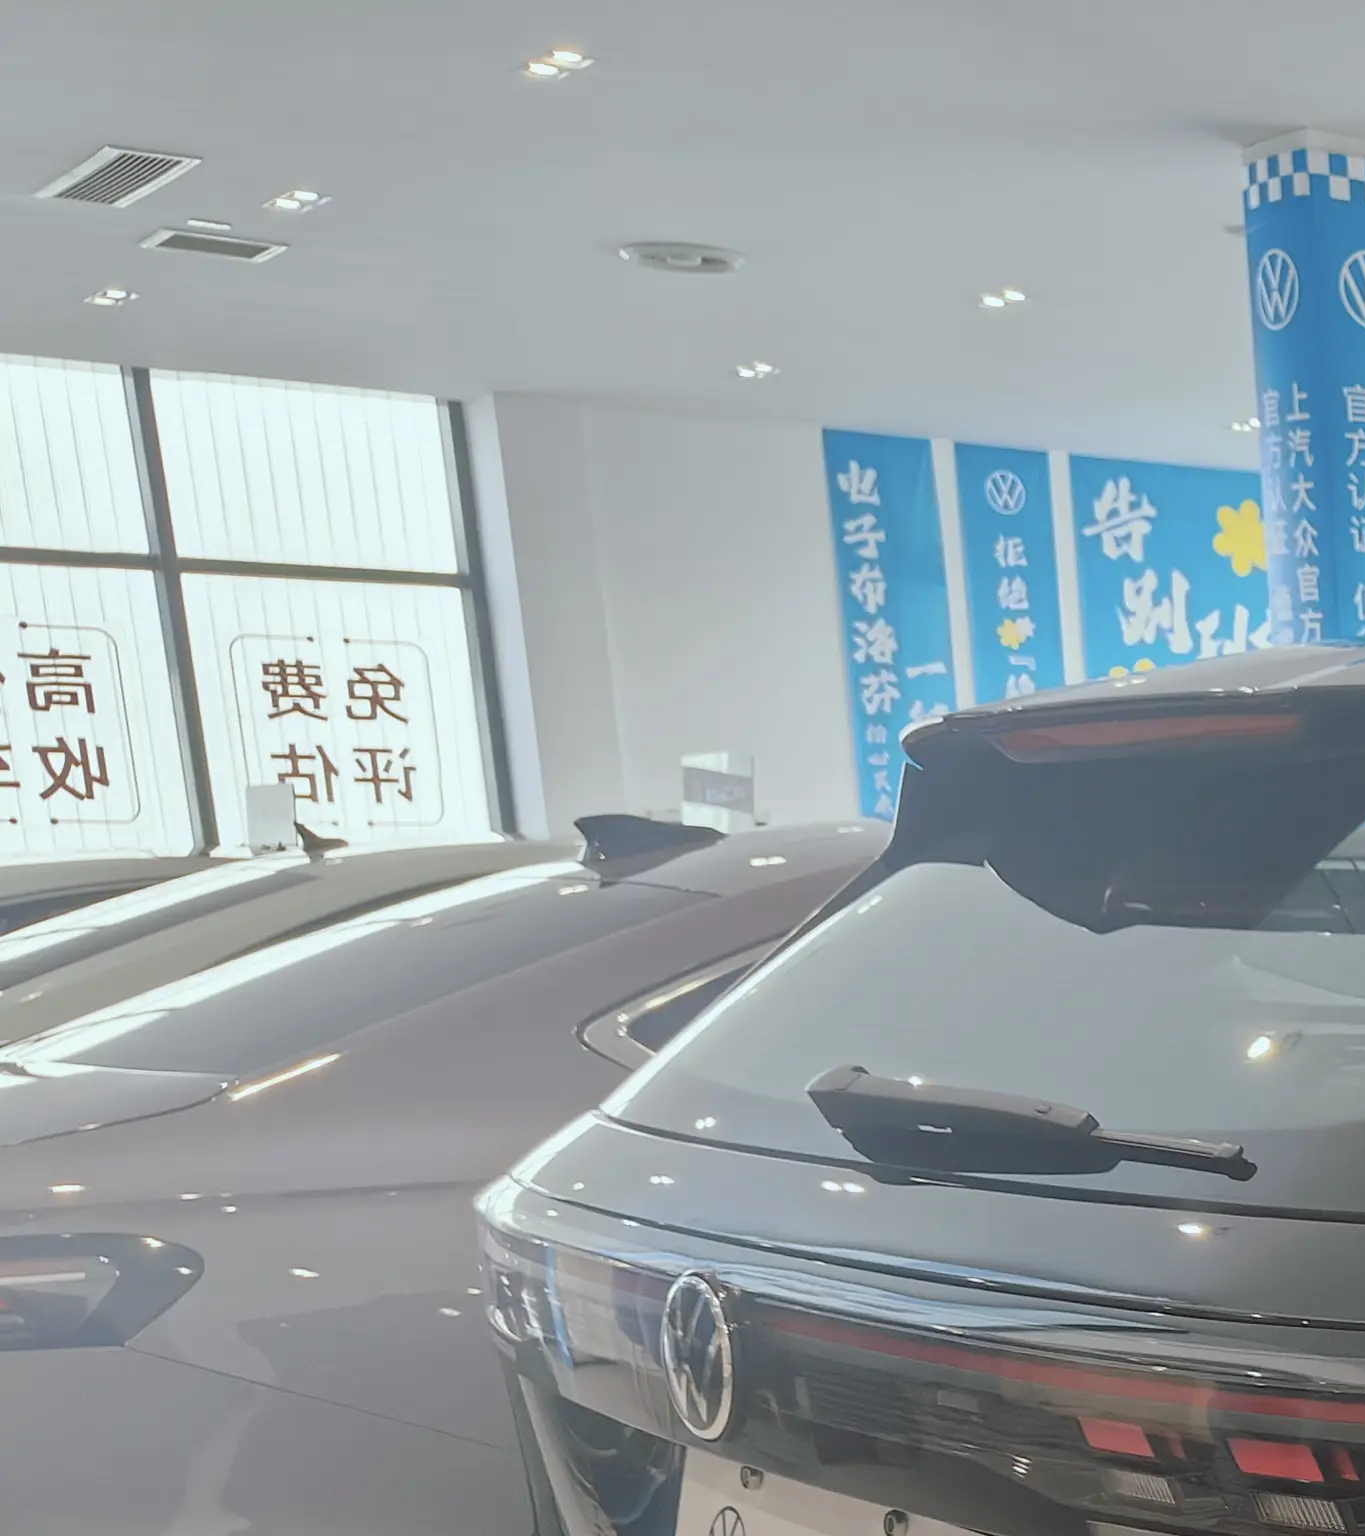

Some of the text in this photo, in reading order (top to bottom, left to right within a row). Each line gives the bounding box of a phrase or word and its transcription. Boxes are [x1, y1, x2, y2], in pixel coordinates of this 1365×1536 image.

[837, 460, 900, 716] 电子布洛芬
[1286, 382, 1324, 645] 上汽大众官方
